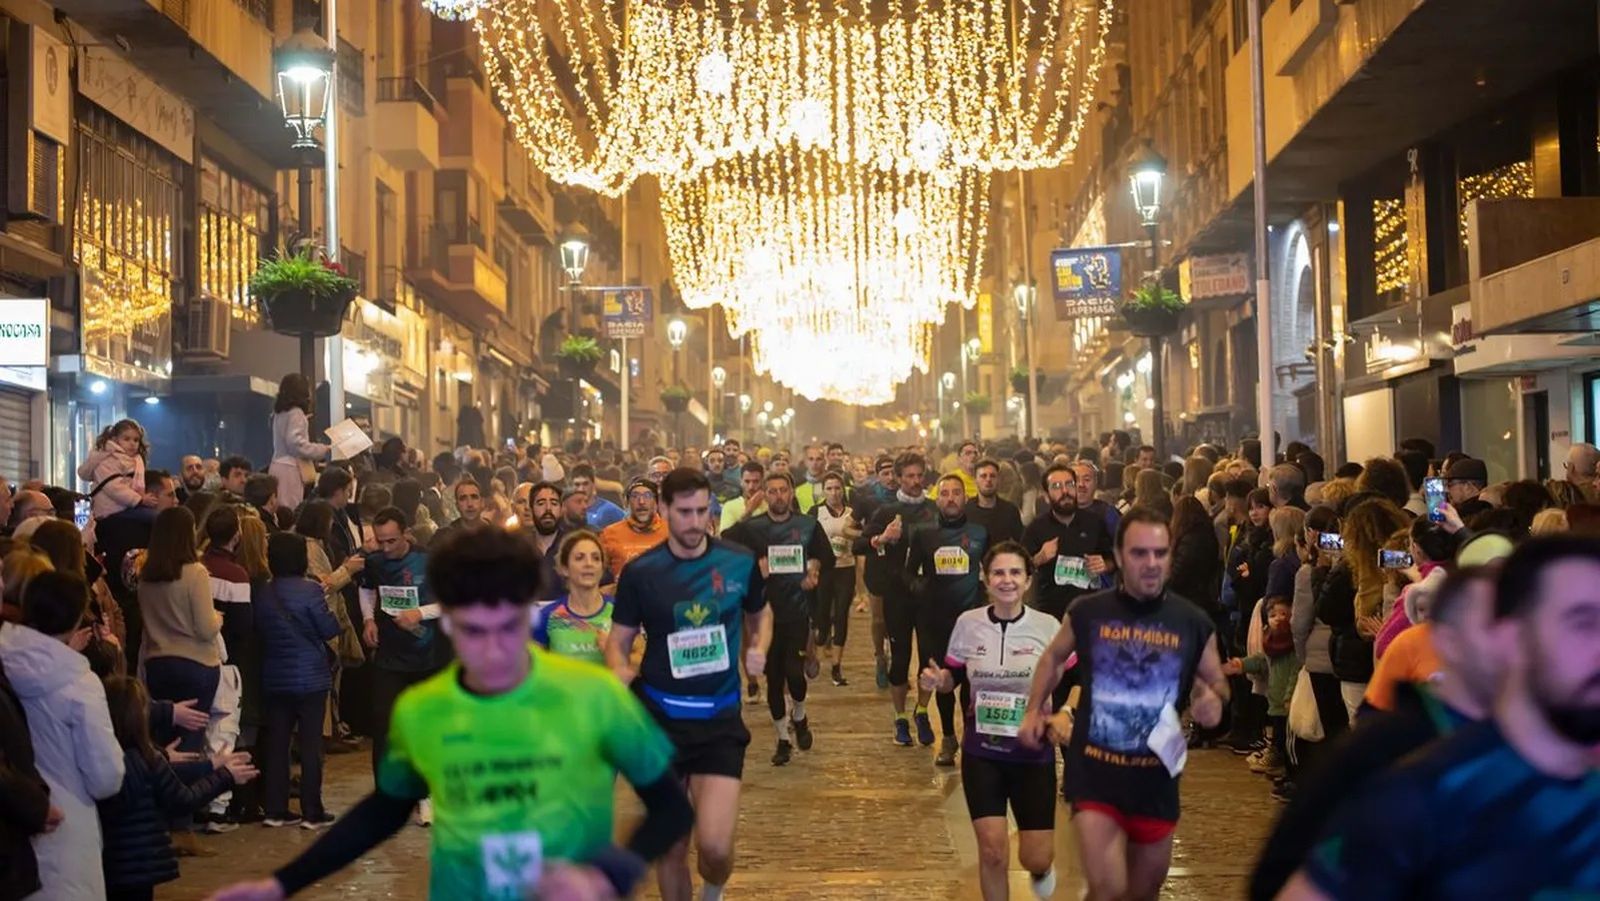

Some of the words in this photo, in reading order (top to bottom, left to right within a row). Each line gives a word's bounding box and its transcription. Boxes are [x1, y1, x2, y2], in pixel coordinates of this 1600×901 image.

[1065, 298, 1115, 307] DACIA
[1067, 305, 1115, 316] JAPEMASA
[1099, 624, 1130, 641] IRON
[1133, 627, 1180, 649] MAIDEN
[682, 644, 718, 660] 4622
